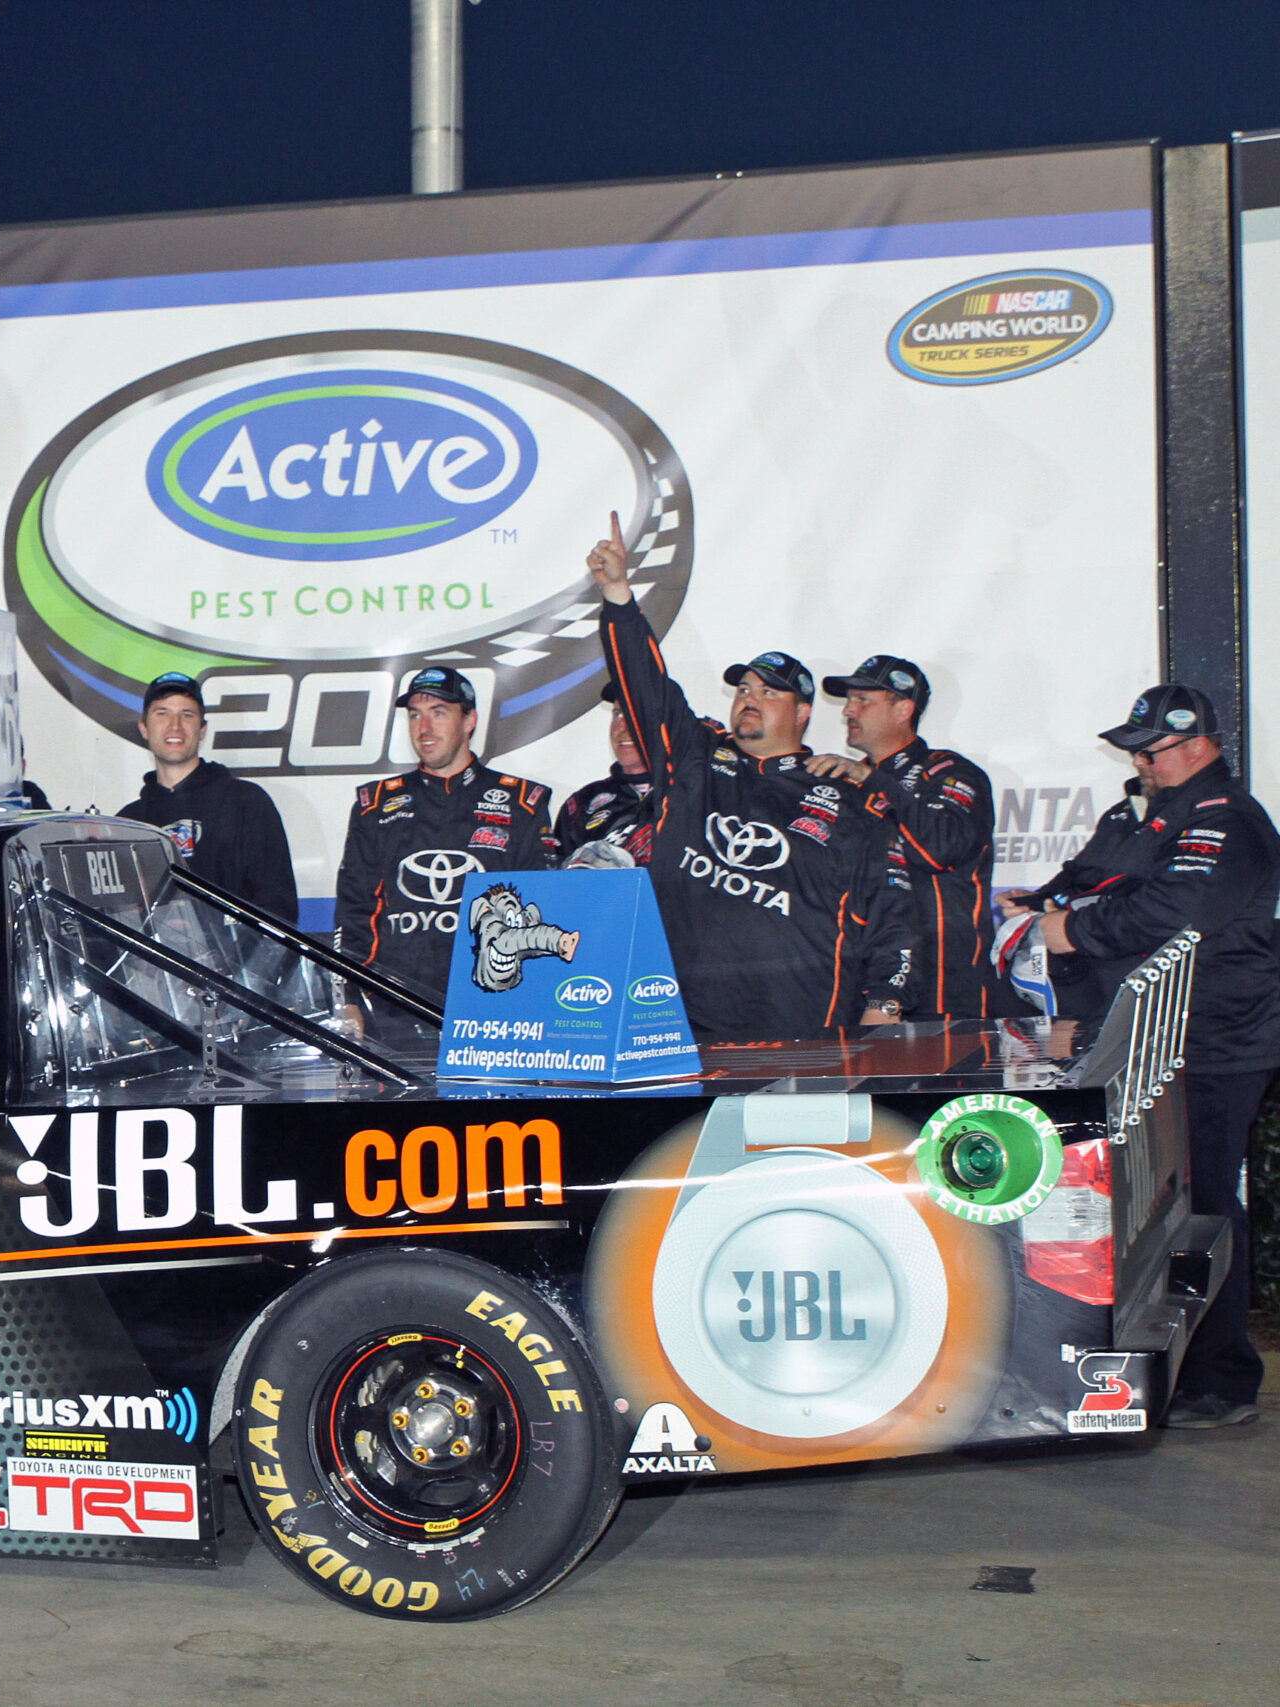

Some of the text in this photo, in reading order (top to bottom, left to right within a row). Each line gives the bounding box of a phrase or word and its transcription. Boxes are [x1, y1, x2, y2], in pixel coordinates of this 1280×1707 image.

[995, 289, 1072, 313] NASCAR
[912, 314, 1088, 342] CAMPING WORLD
[919, 345, 1030, 362] TRUCK SERIES
[199, 417, 505, 505] Active
[189, 583, 494, 619] PEST CONTROL
[86, 850, 125, 895] BELL
[679, 846, 790, 917] TOYOTA
[560, 983, 612, 1005] Active
[633, 981, 680, 998] Active
[453, 1020, 544, 1041] 770-954-9941
[554, 1020, 603, 1029] PEST CONTROL
[632, 1032, 681, 1047] 770-954-9941
[446, 1047, 606, 1072] activepestcontrol.com
[616, 1044, 698, 1061] activepestcontrol.com
[928, 1093, 1058, 1141] AMERICAN
[10, 1105, 563, 1237] JBL.com
[935, 1182, 1056, 1223] ETHANOL
[732, 1270, 867, 1343] JBL
[464, 1290, 583, 1413] EAGLE
[25, 1437, 107, 1453] SCHROTH
[26, 1451, 107, 1460] RACING
[11, 1460, 192, 1480] TOYOTA RACING DEVELOPMENT
[622, 1455, 716, 1474] AXALTA
[11, 1474, 194, 1534] TRD
[248, 1378, 440, 1612] GOODYEAR
